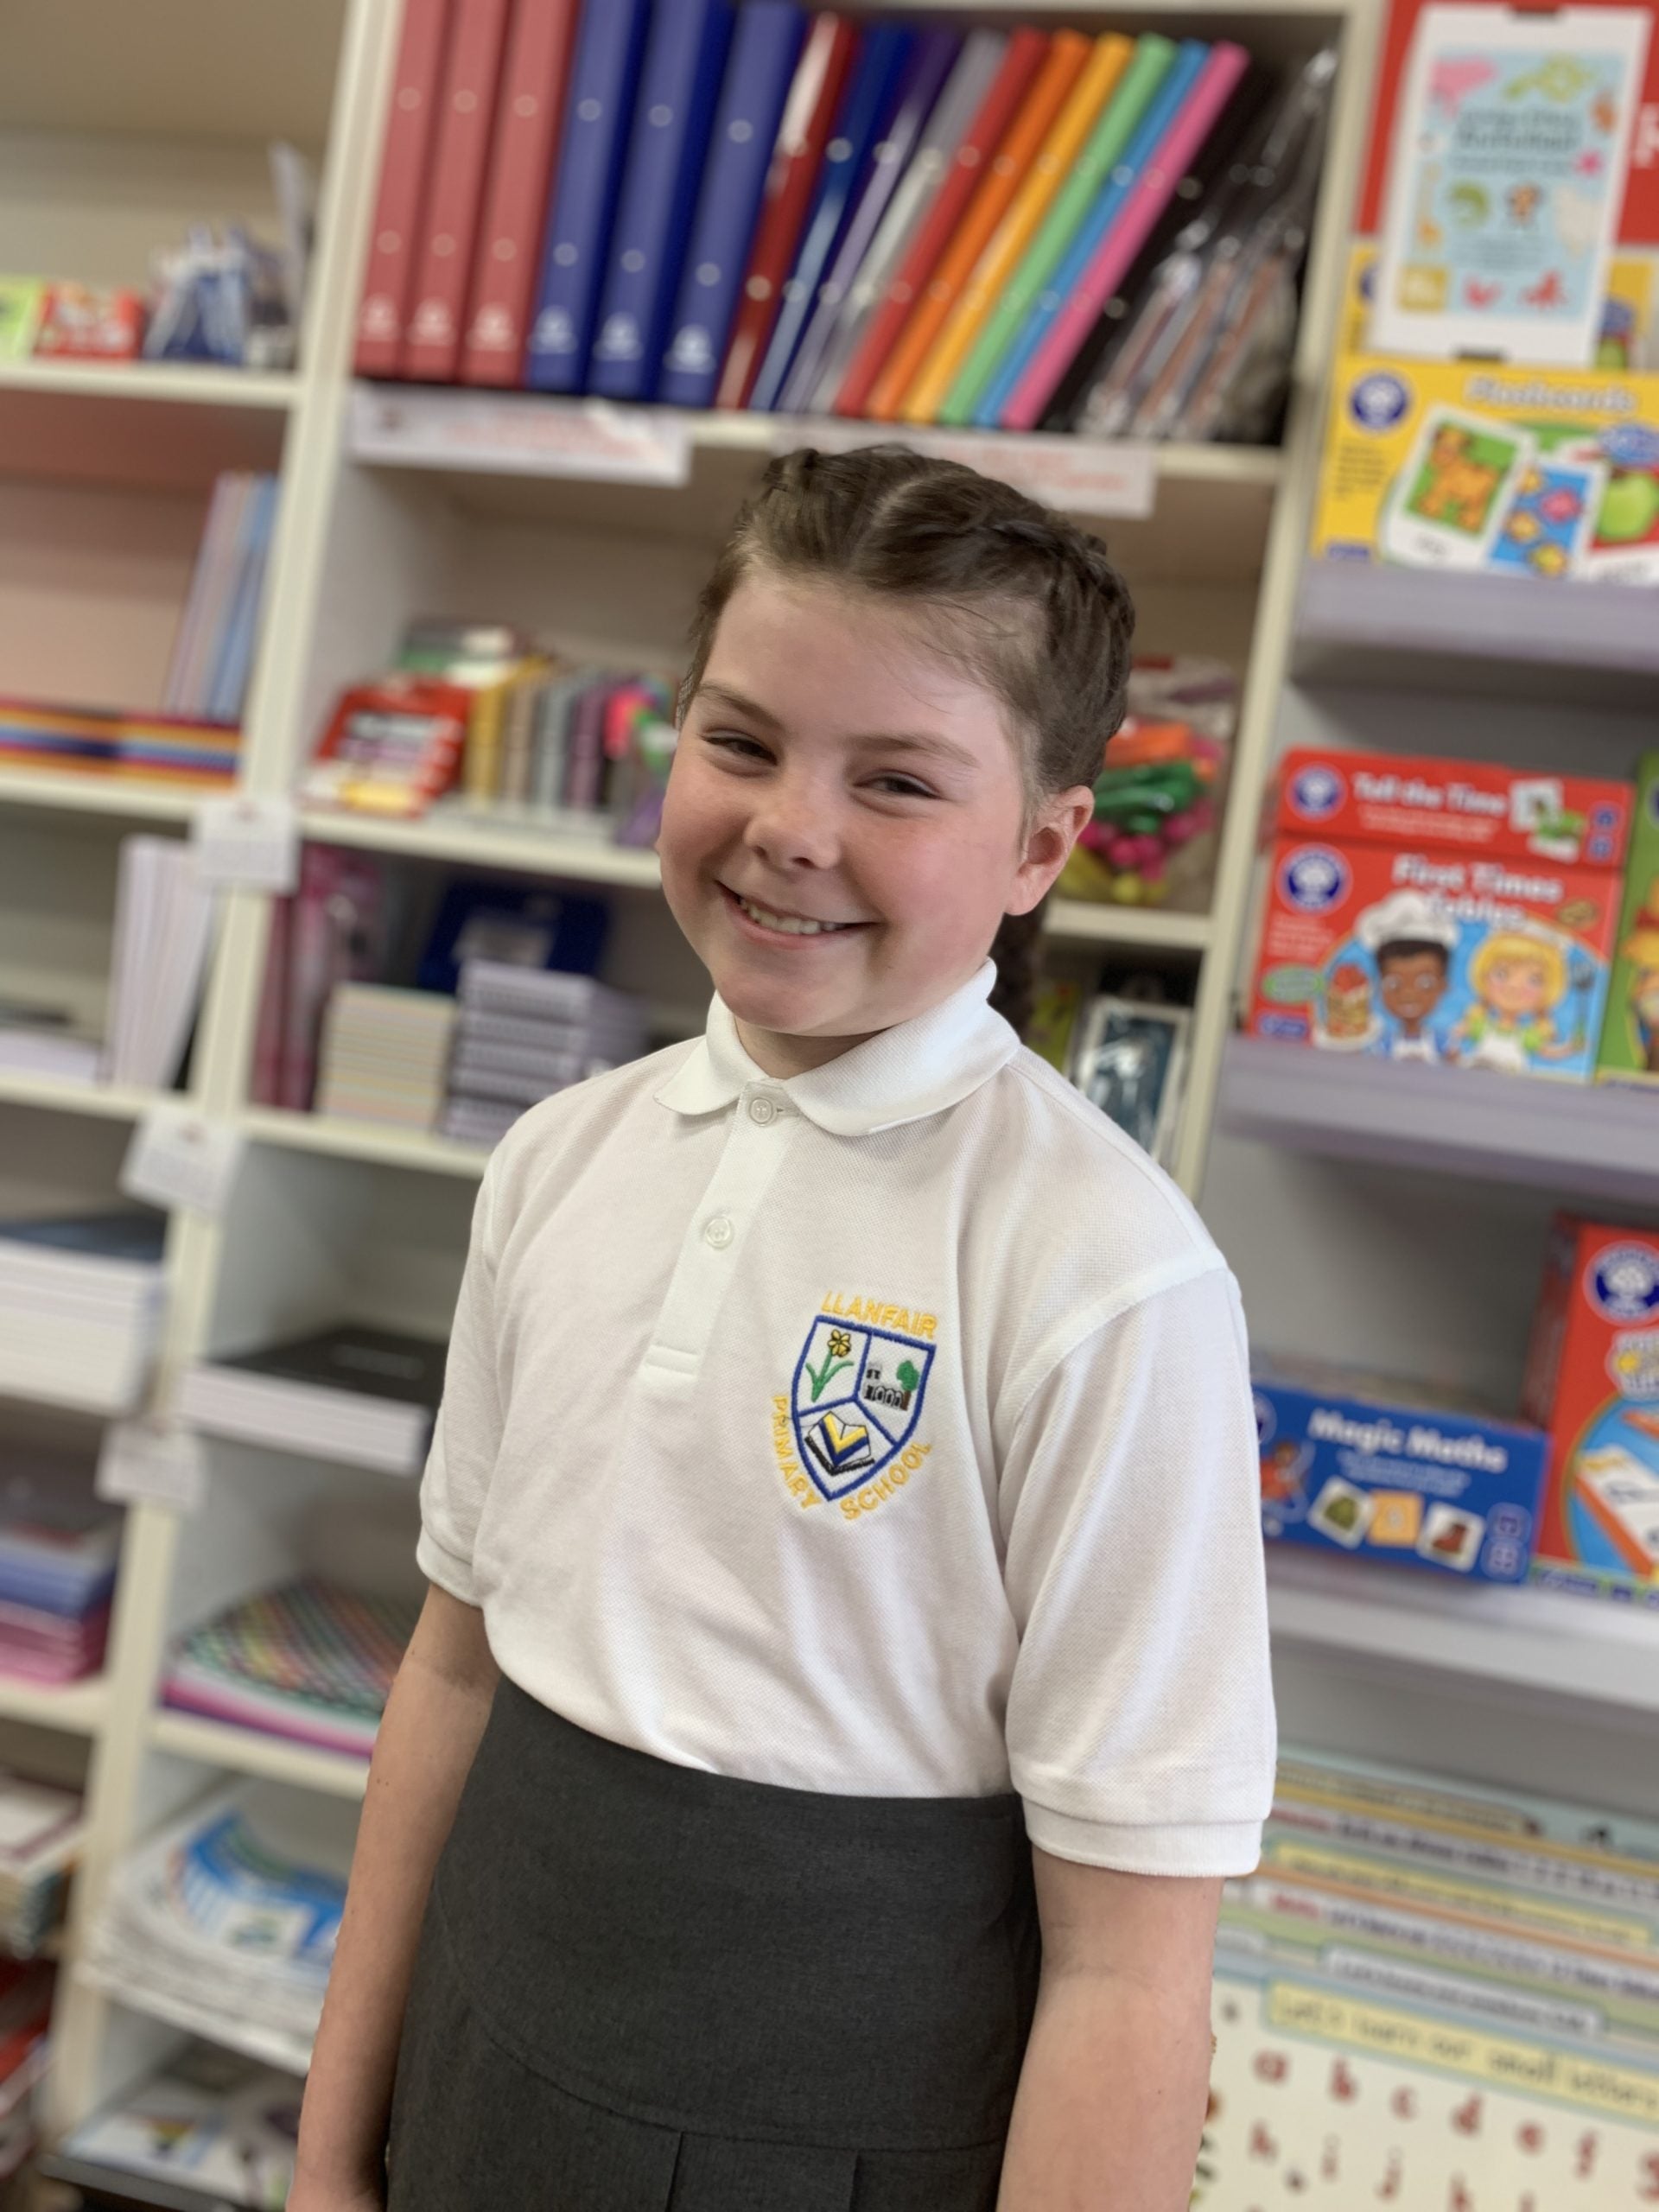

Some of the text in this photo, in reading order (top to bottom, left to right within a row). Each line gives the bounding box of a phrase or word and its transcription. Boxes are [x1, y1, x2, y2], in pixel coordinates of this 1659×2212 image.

[1446, 782, 1508, 817] Time
[1393, 853, 1564, 904] First Times
[821, 1291, 938, 1339] LLANFAIR
[772, 1395, 822, 1509] PRIMARY
[1308, 1407, 1404, 1454] Magic
[1406, 1427, 1508, 1474] Maths
[839, 1441, 933, 1520] SCHOOL
